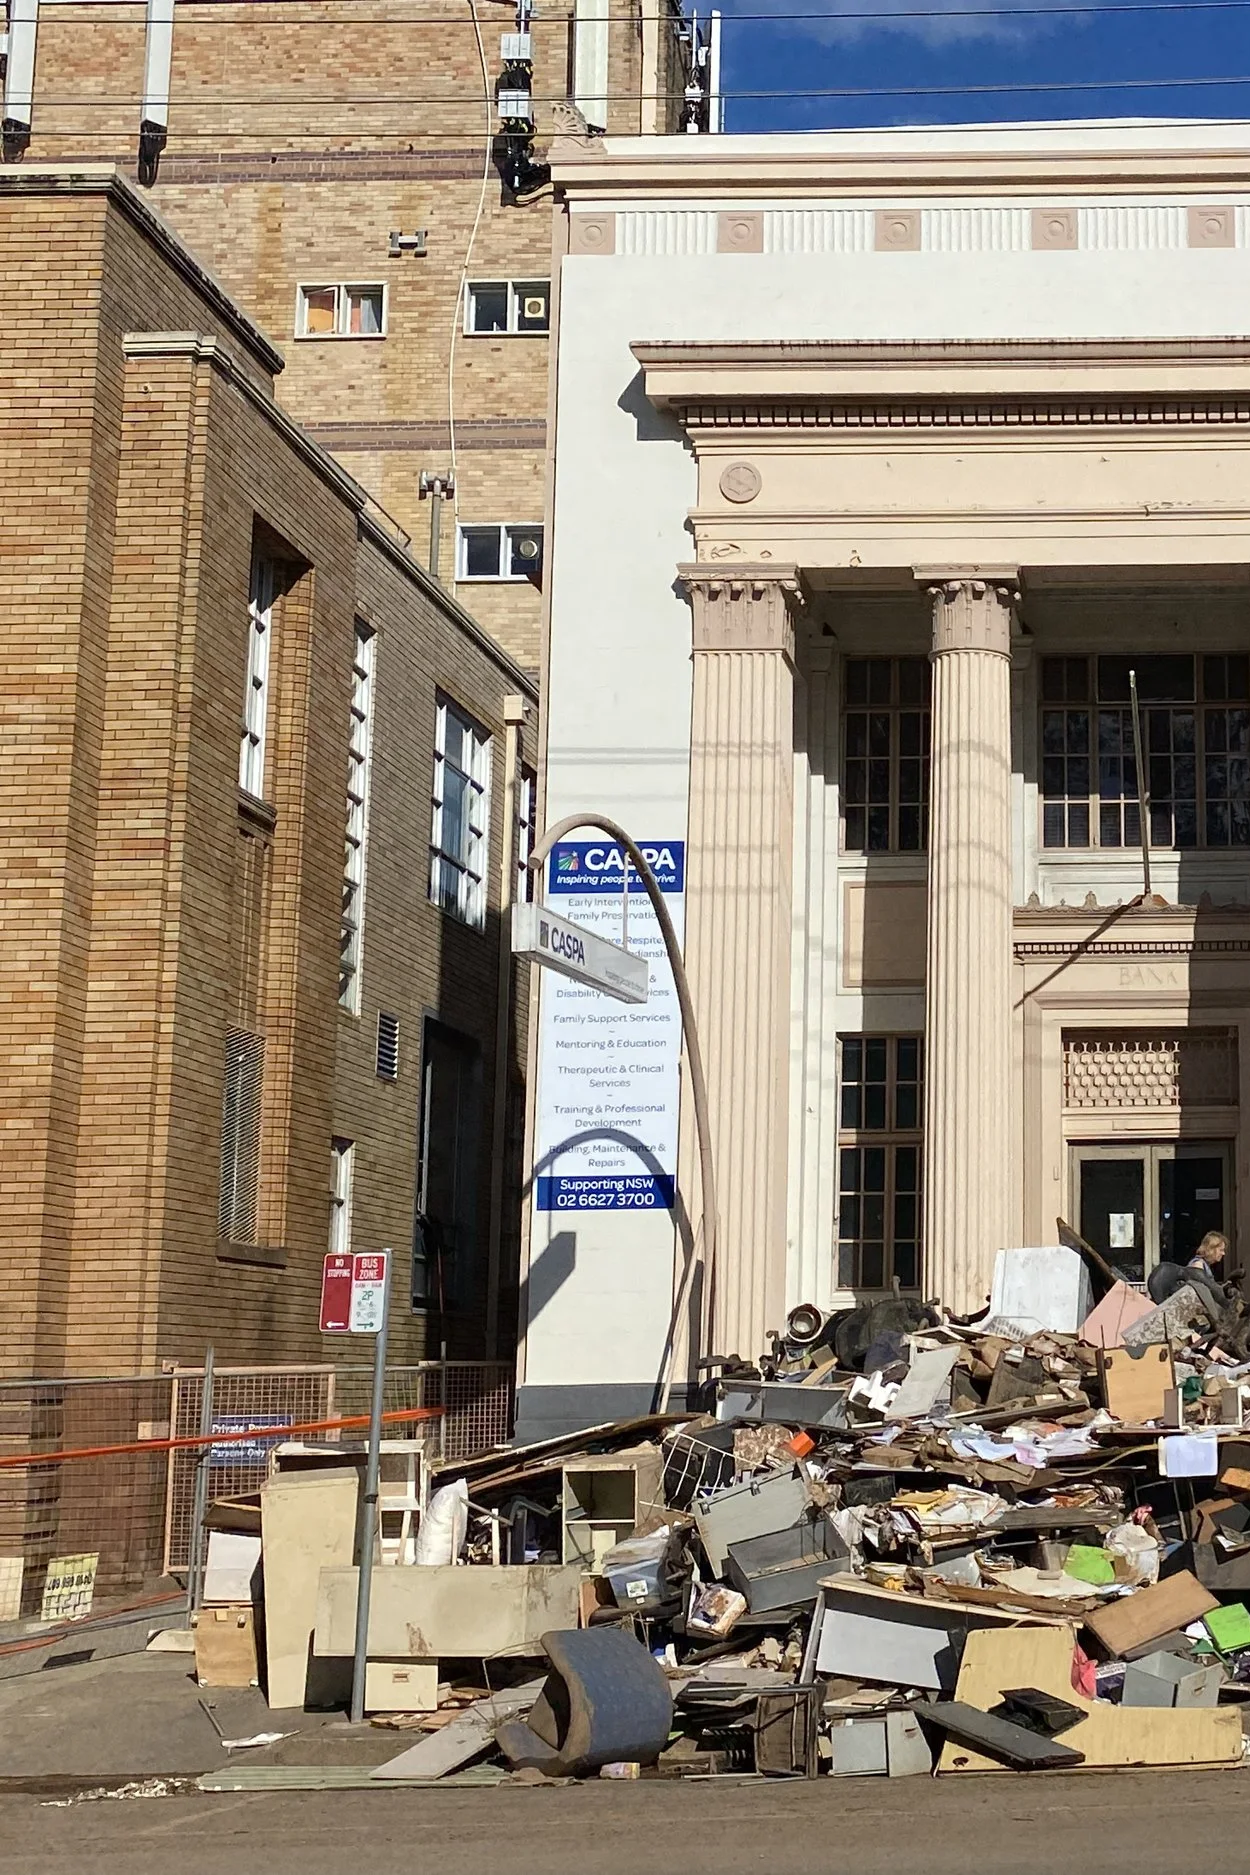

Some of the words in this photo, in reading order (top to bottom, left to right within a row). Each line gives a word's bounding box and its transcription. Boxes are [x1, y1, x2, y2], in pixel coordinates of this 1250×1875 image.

[557, 875, 598, 885] Inspiring
[600, 874, 633, 885] peope
[568, 899, 591, 907] Early
[568, 912, 599, 921] Family
[551, 928, 585, 965] CASPA
[1119, 966, 1178, 986] BANK
[556, 988, 600, 999] Disability
[553, 1014, 586, 1025] Family
[587, 1014, 627, 1024] Support
[629, 1013, 670, 1023] Services
[555, 1040, 605, 1050] Mentoring
[607, 1040, 615, 1048] &
[616, 1039, 667, 1048] Education
[558, 1065, 618, 1076] Therapeutic
[619, 1065, 627, 1073] &
[628, 1064, 664, 1073] Clinical
[589, 1079, 631, 1088] Services
[554, 1105, 593, 1115] Training
[595, 1105, 603, 1113] &
[604, 1104, 666, 1114] Professional
[575, 1118, 642, 1129] Development
[592, 1144, 656, 1153] Maintenance
[658, 1143, 666, 1152] &
[588, 1158, 626, 1168] Repairs
[560, 1178, 624, 1192] Supporting
[626, 1178, 654, 1188] NSW
[557, 1195, 576, 1207] 02
[579, 1194, 618, 1206] 6627
[619, 1193, 655, 1205] 3700
[335, 1258, 344, 1267] NO
[361, 1258, 378, 1268] BUS
[359, 1269, 379, 1279] ZONE
[362, 1290, 374, 1301] 2P
